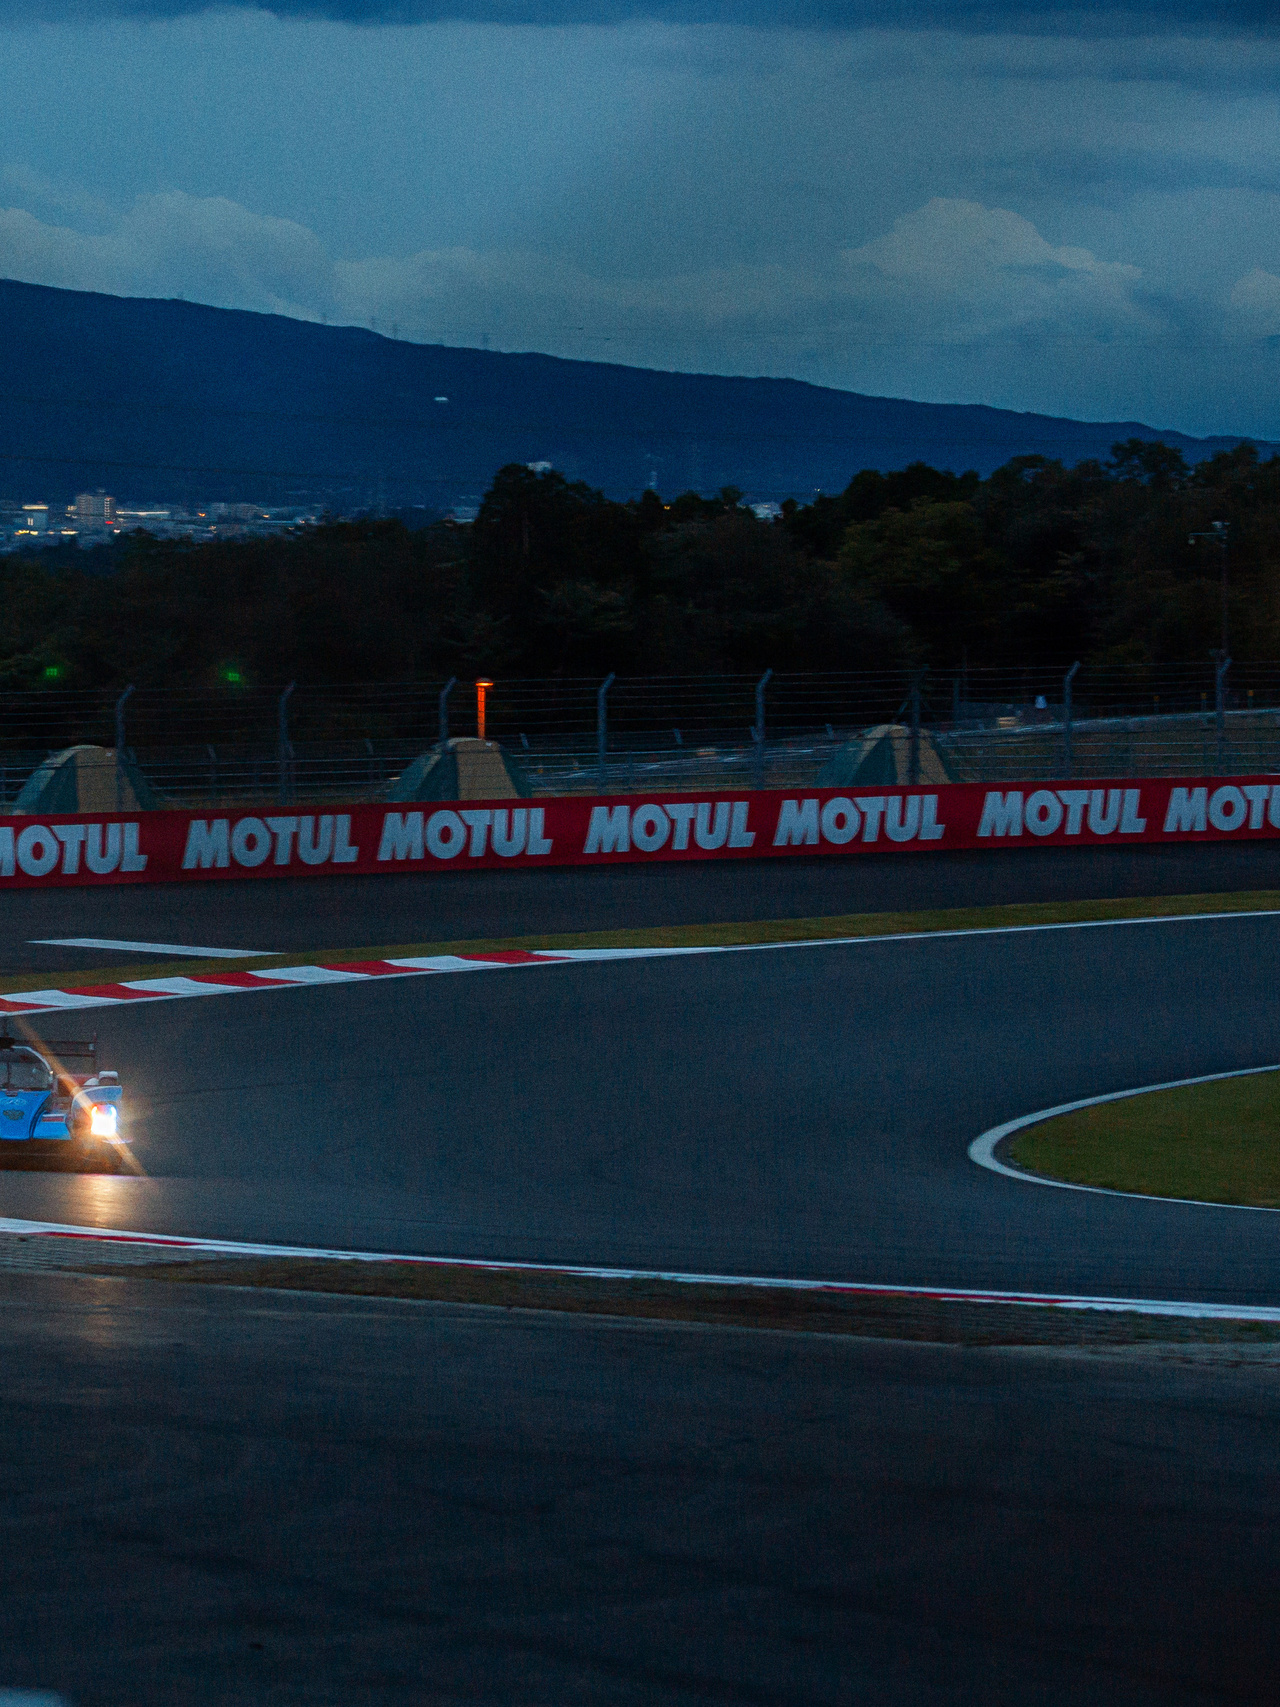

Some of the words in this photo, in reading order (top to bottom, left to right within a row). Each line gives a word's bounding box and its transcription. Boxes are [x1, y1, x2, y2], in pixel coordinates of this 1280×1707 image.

[182, 814, 359, 870] MOTUL
[377, 807, 554, 861] MOTUL
[583, 800, 756, 854] MOTUL
[773, 794, 946, 847] MOTUL
[976, 788, 1147, 838] MOTUL
